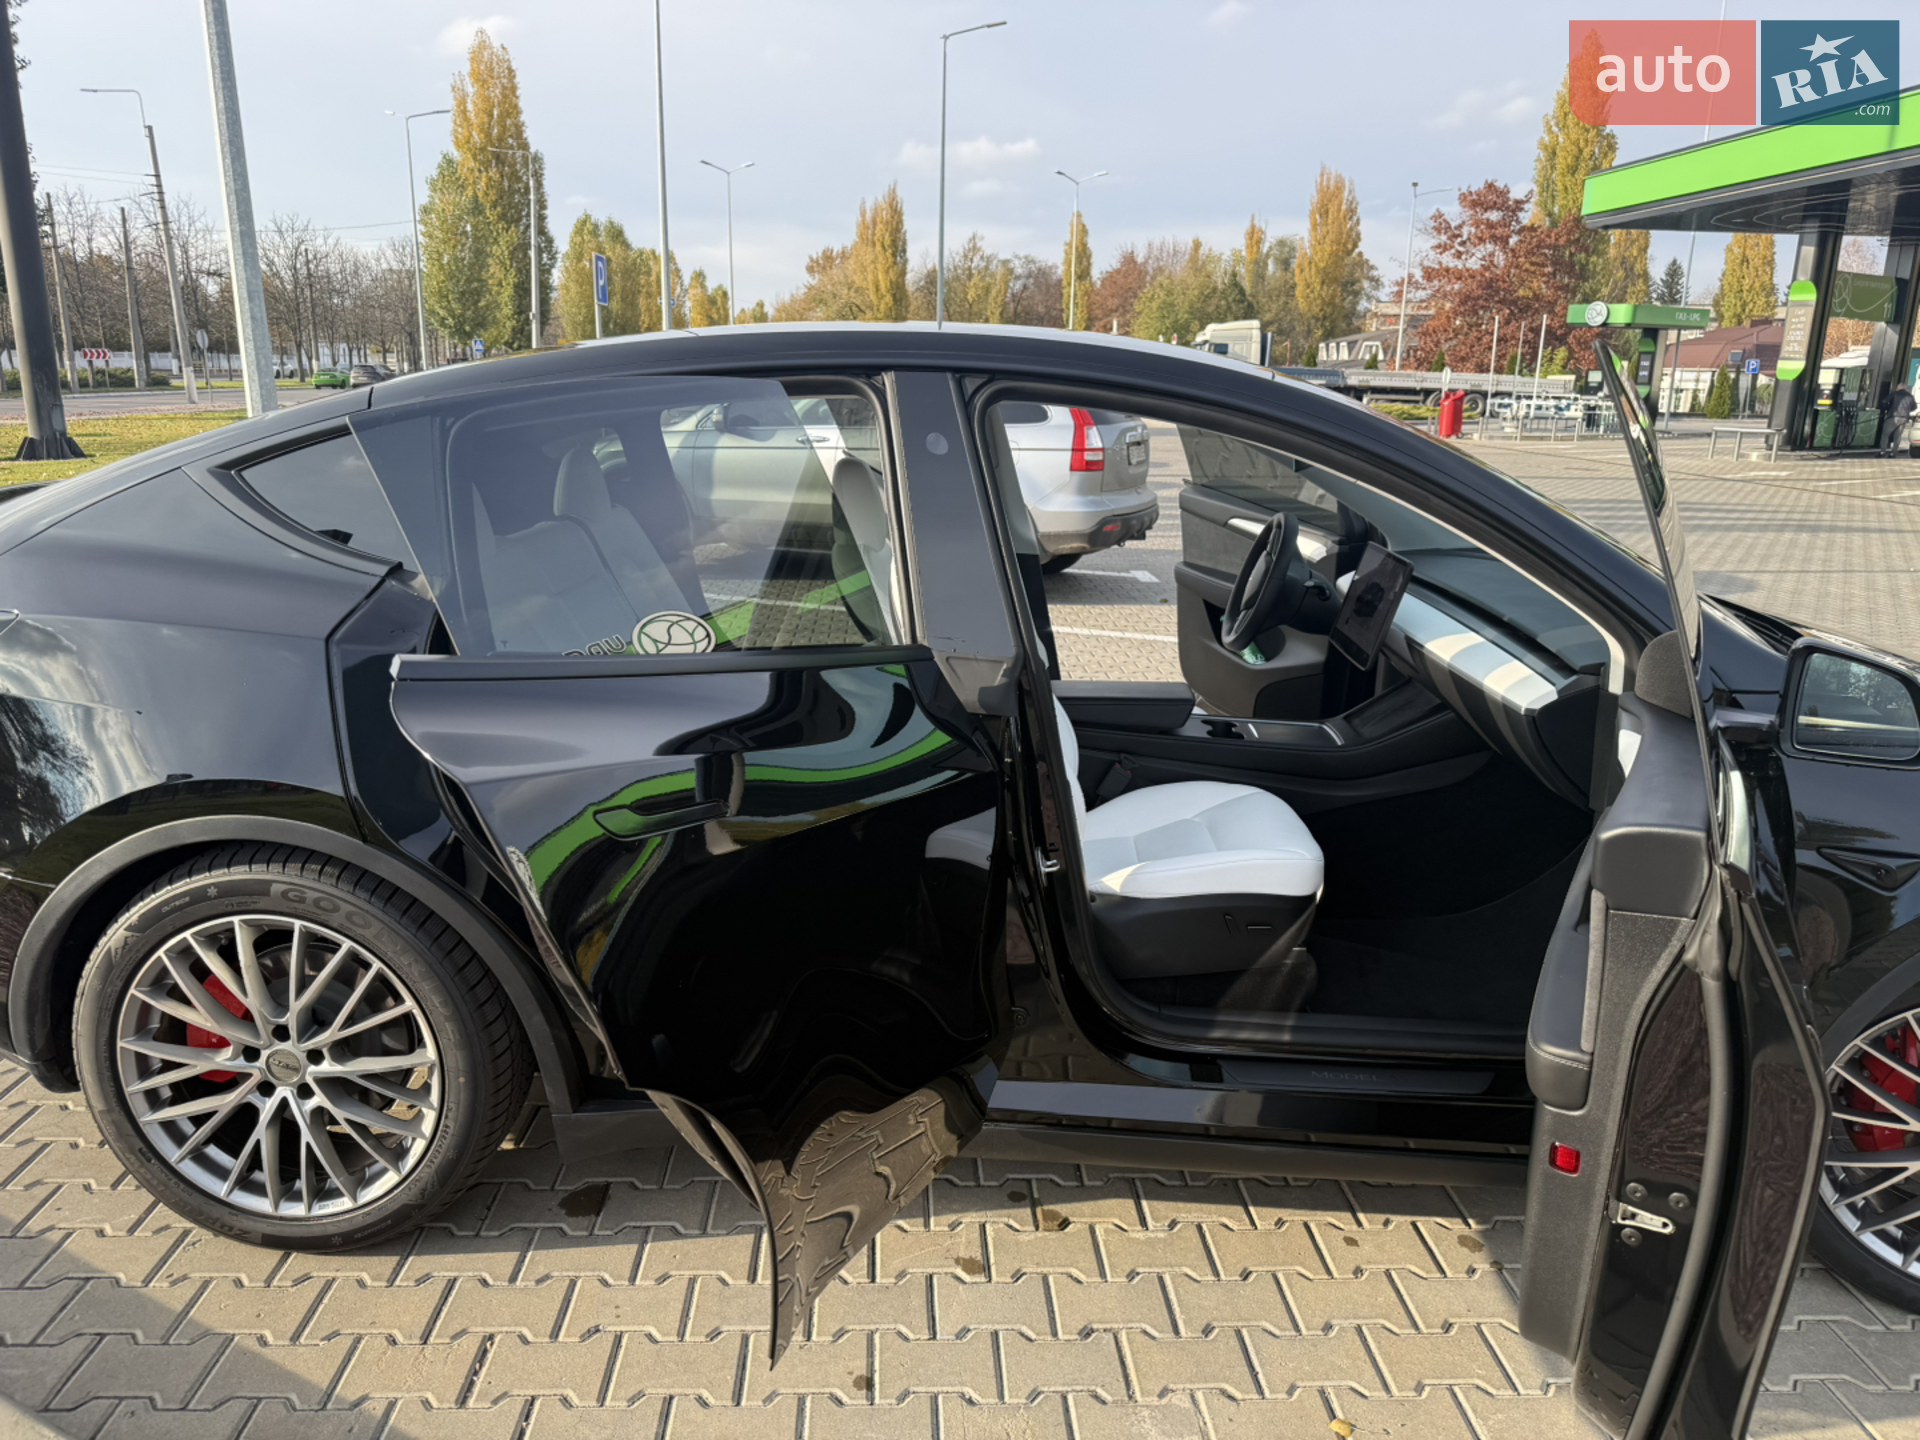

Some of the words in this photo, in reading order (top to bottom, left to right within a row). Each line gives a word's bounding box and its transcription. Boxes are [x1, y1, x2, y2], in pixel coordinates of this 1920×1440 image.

[597, 260, 605, 299] P
[1748, 360, 1757, 372] P
[1310, 1070, 1385, 1083] MODEL
